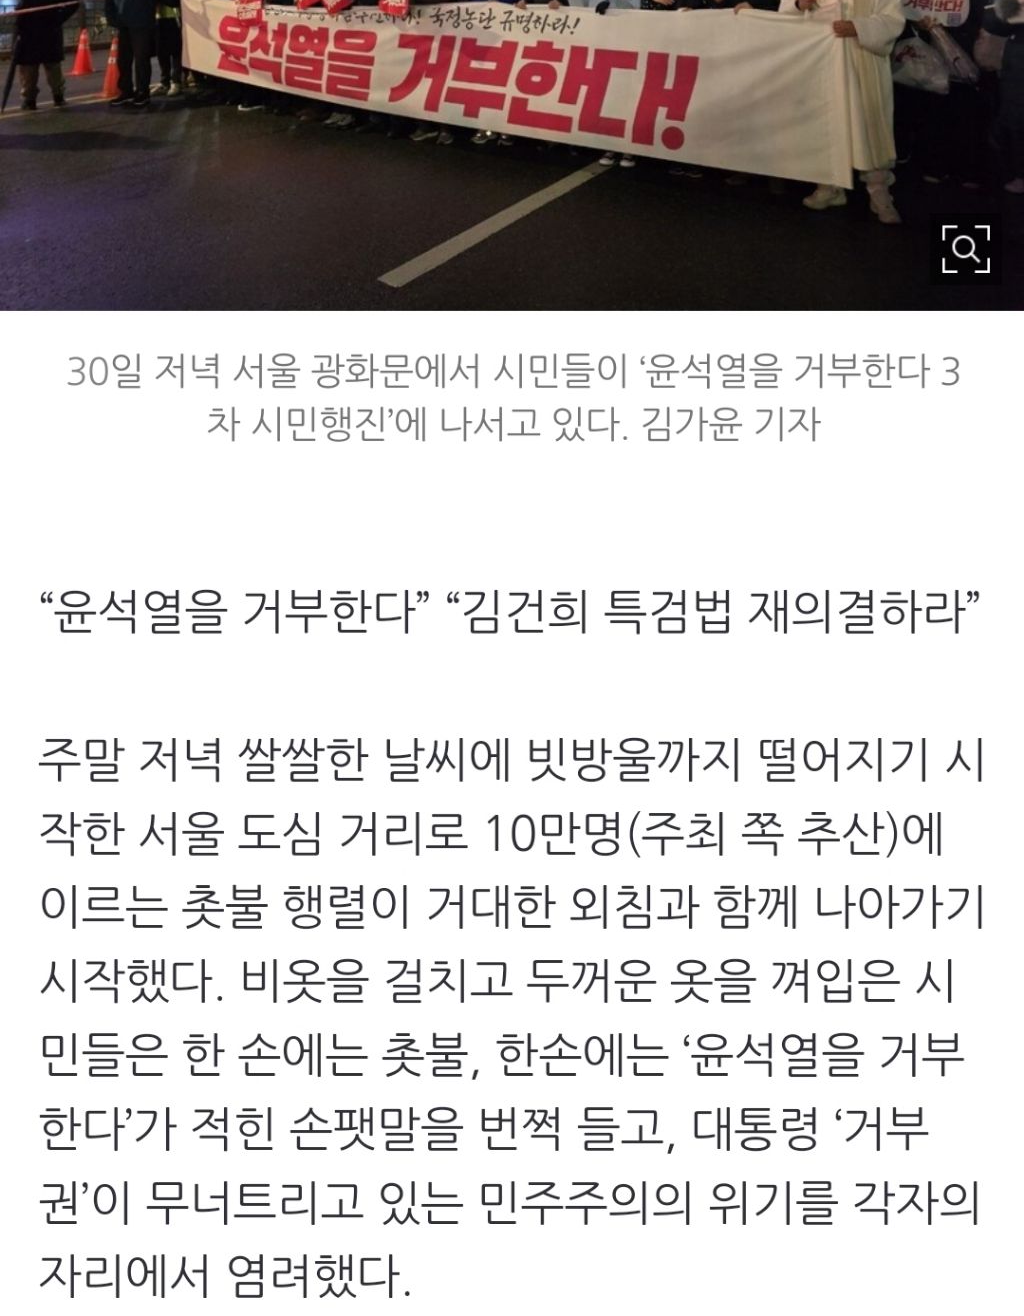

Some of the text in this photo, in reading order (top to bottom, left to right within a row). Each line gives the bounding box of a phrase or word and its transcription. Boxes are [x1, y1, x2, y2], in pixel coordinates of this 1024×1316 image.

[429, 5, 496, 30] 국정농단
[499, 10, 581, 35] 규명하라!
[218, 15, 700, 150] 윤석열을 거부한다!
